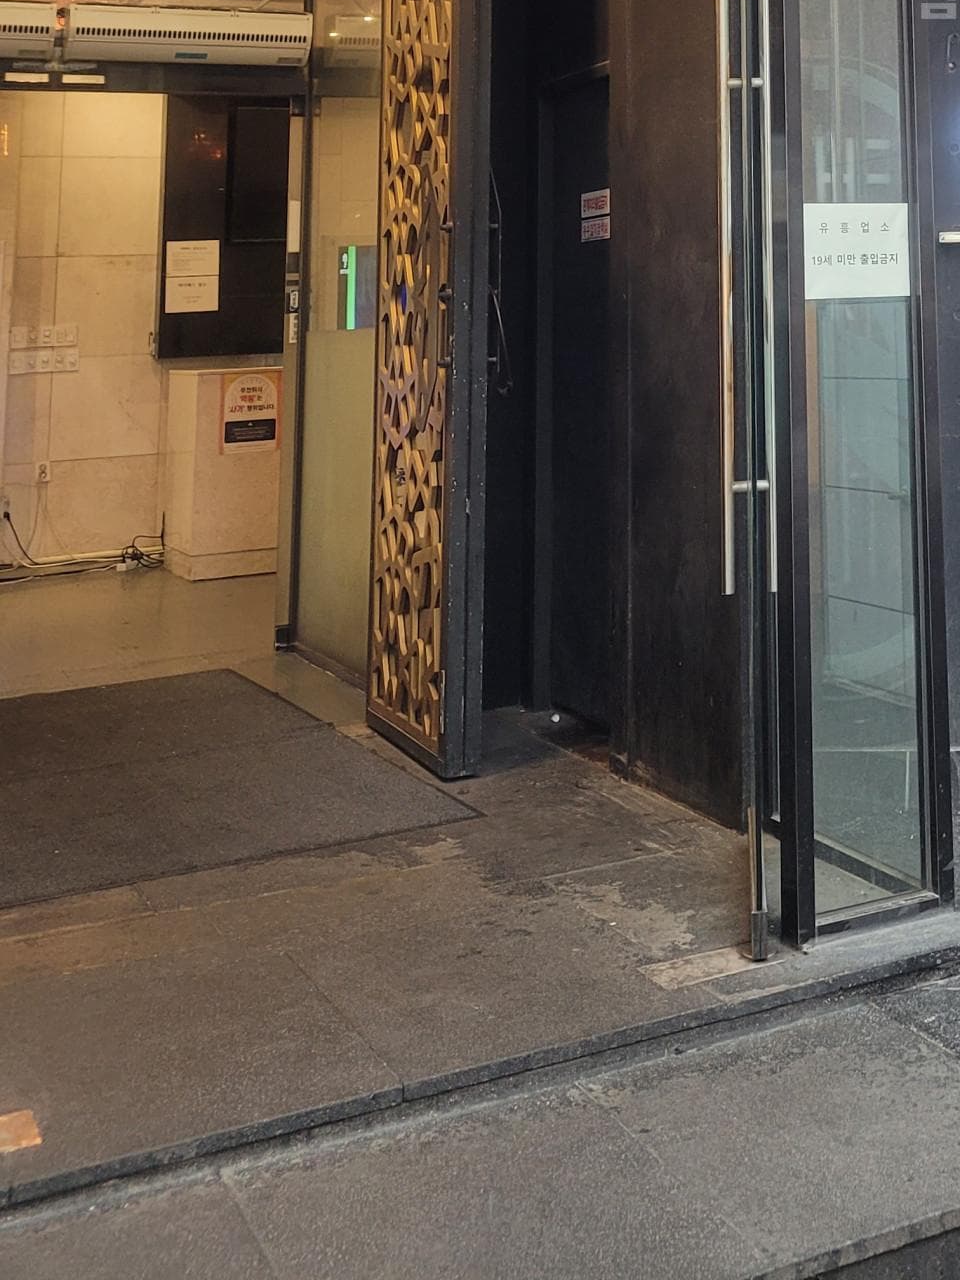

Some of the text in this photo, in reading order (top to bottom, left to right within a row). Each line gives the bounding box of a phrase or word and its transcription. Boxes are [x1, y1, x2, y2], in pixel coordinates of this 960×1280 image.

[811, 252, 898, 266] 19세 미만 출입금지
